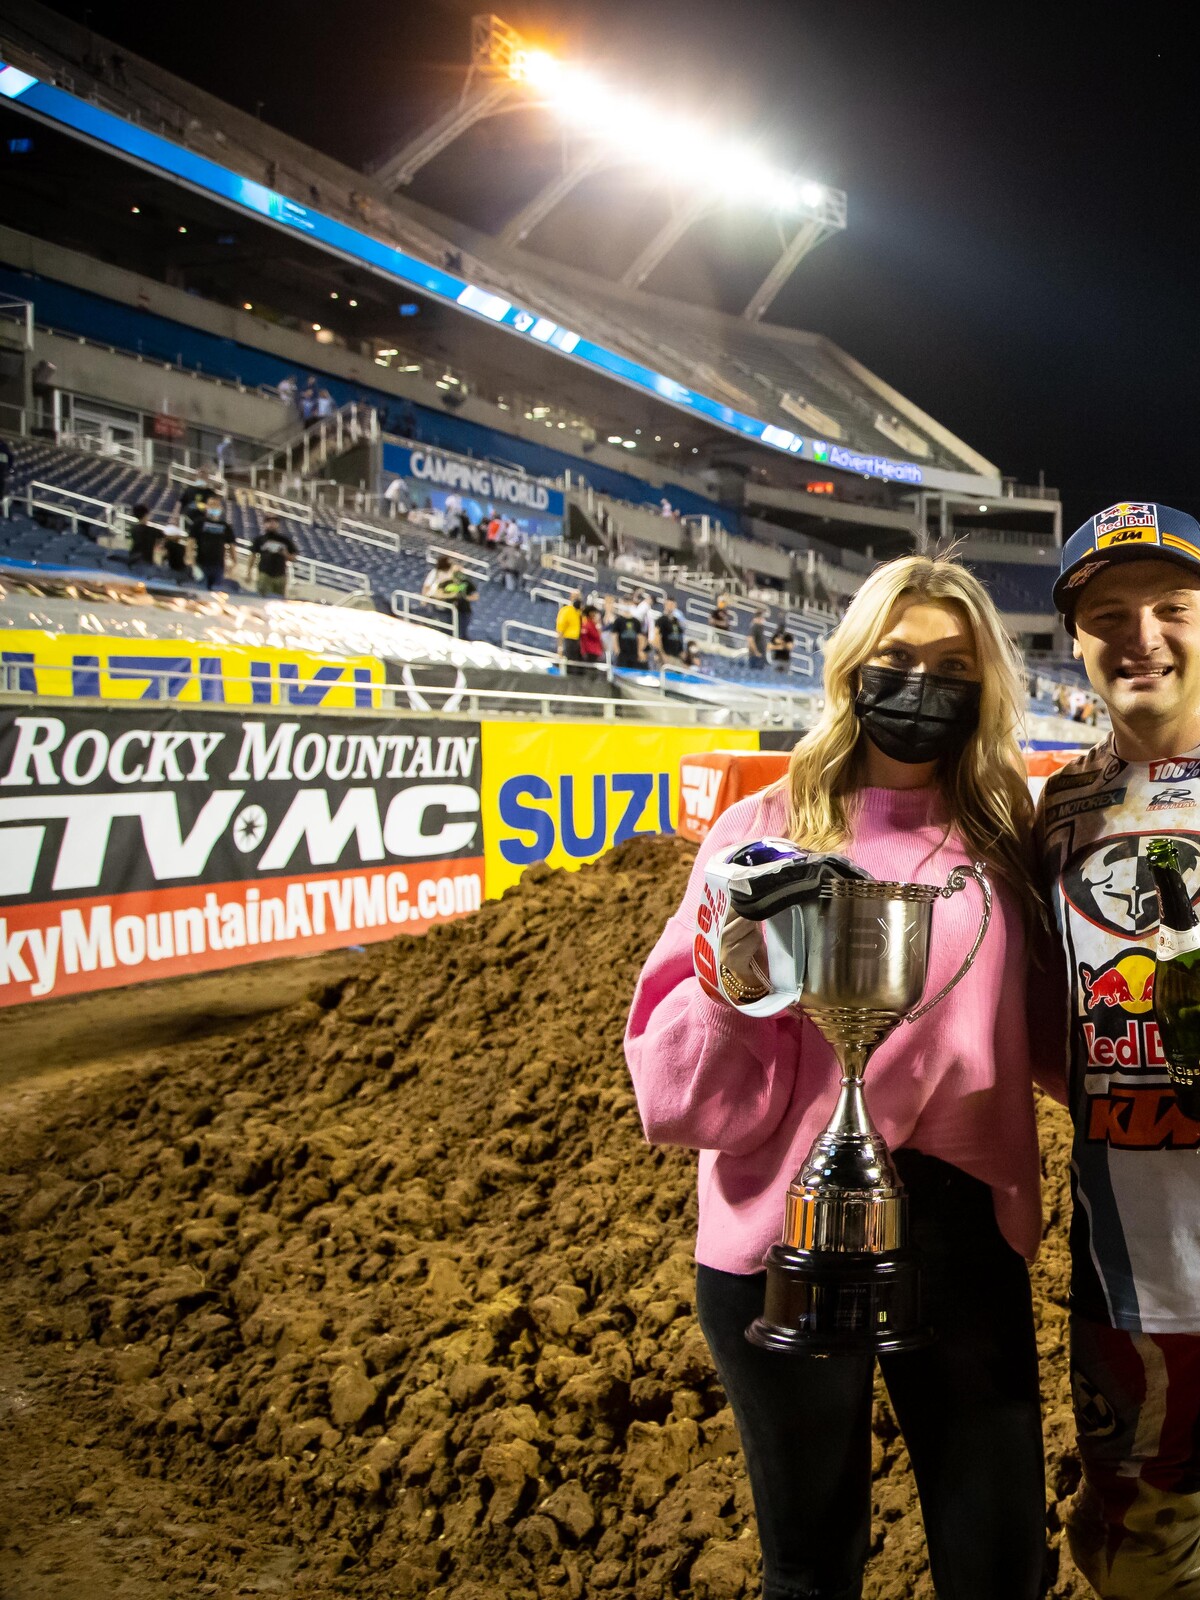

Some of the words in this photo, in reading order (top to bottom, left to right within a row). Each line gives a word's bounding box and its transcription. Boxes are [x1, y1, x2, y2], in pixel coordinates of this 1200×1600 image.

[410, 451, 490, 496] CAMPING
[491, 475, 549, 511] WORLD
[1097, 516, 1123, 537] Red
[1126, 514, 1155, 528] Bull
[1109, 530, 1143, 545] KTM
[0, 716, 225, 786] ROCKY
[229, 721, 480, 782] MOUNTAIN
[1153, 760, 1200, 781] 100%
